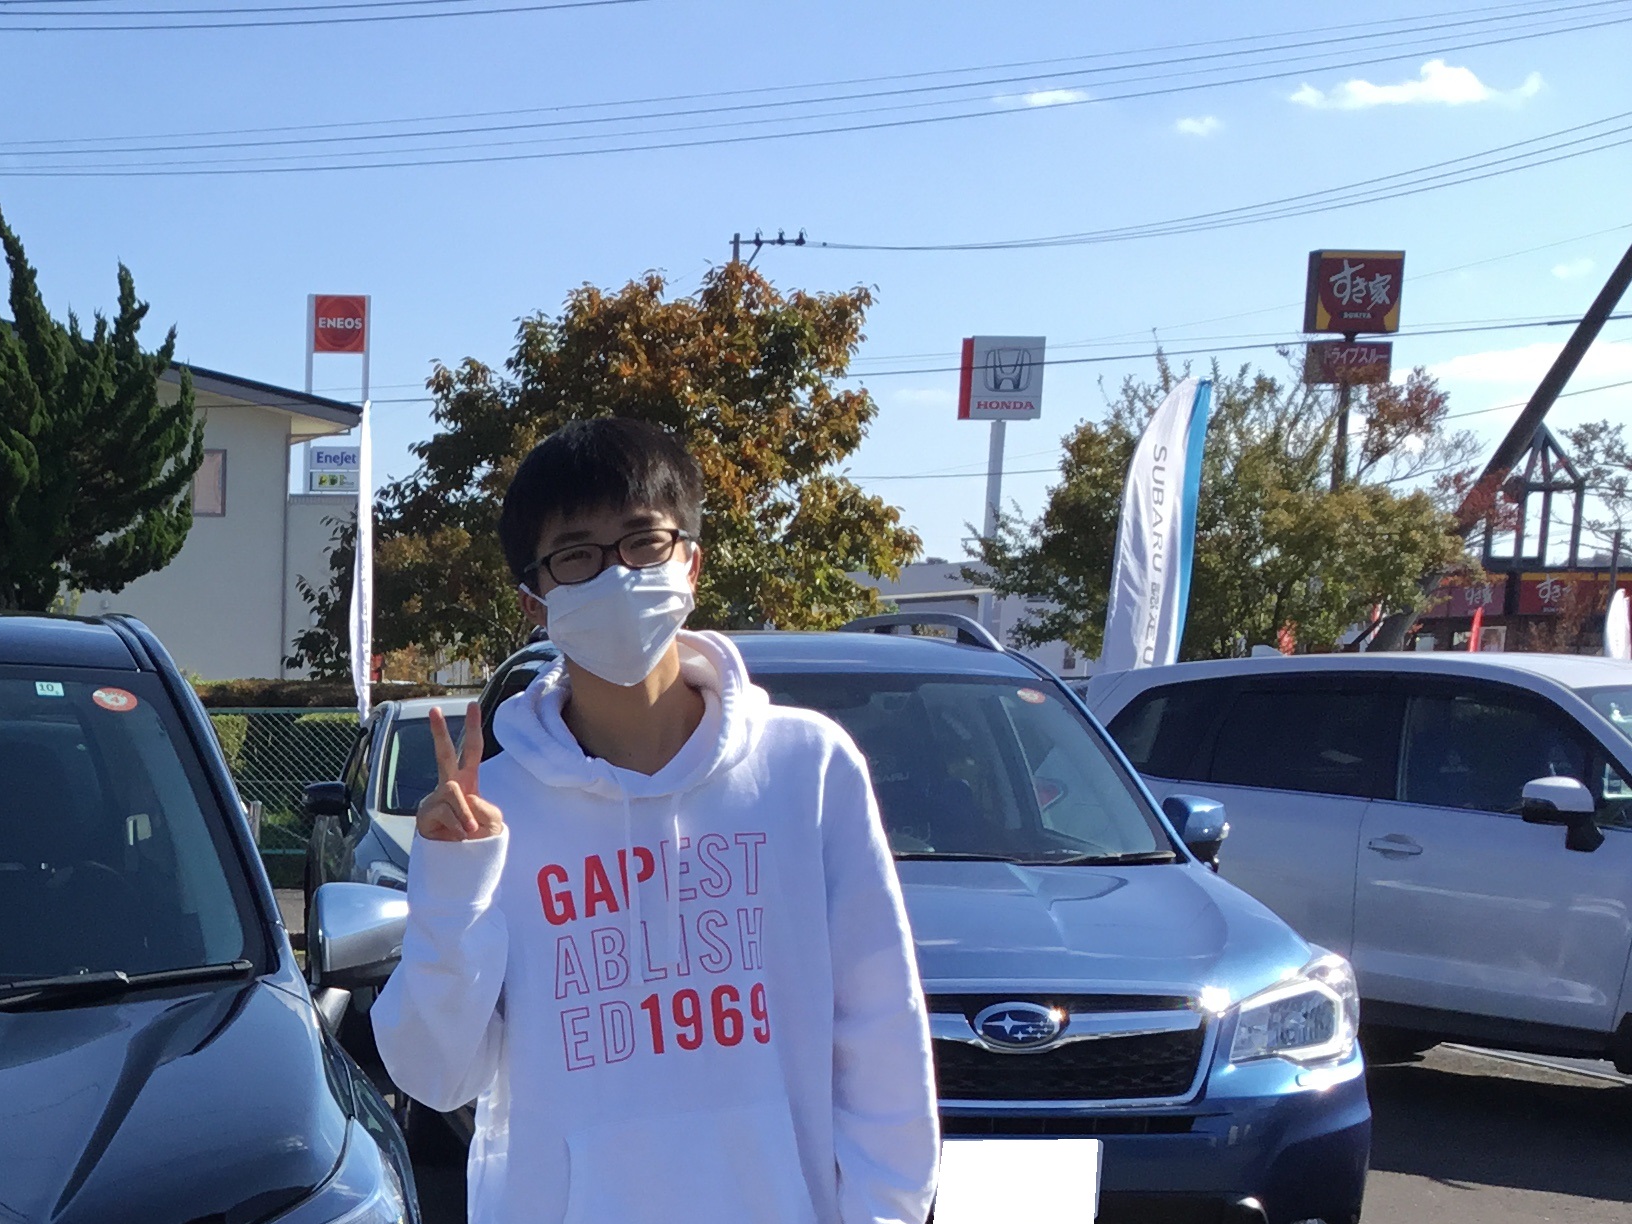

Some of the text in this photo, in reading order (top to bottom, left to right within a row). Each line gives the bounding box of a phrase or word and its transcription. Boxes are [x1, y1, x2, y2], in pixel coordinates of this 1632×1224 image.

[1329, 259, 1392, 310] すき家
[318, 317, 363, 329] ENEOS
[976, 401, 1035, 411] HONDA
[316, 451, 357, 466] EneJet
[1151, 444, 1167, 572] SUBARU
